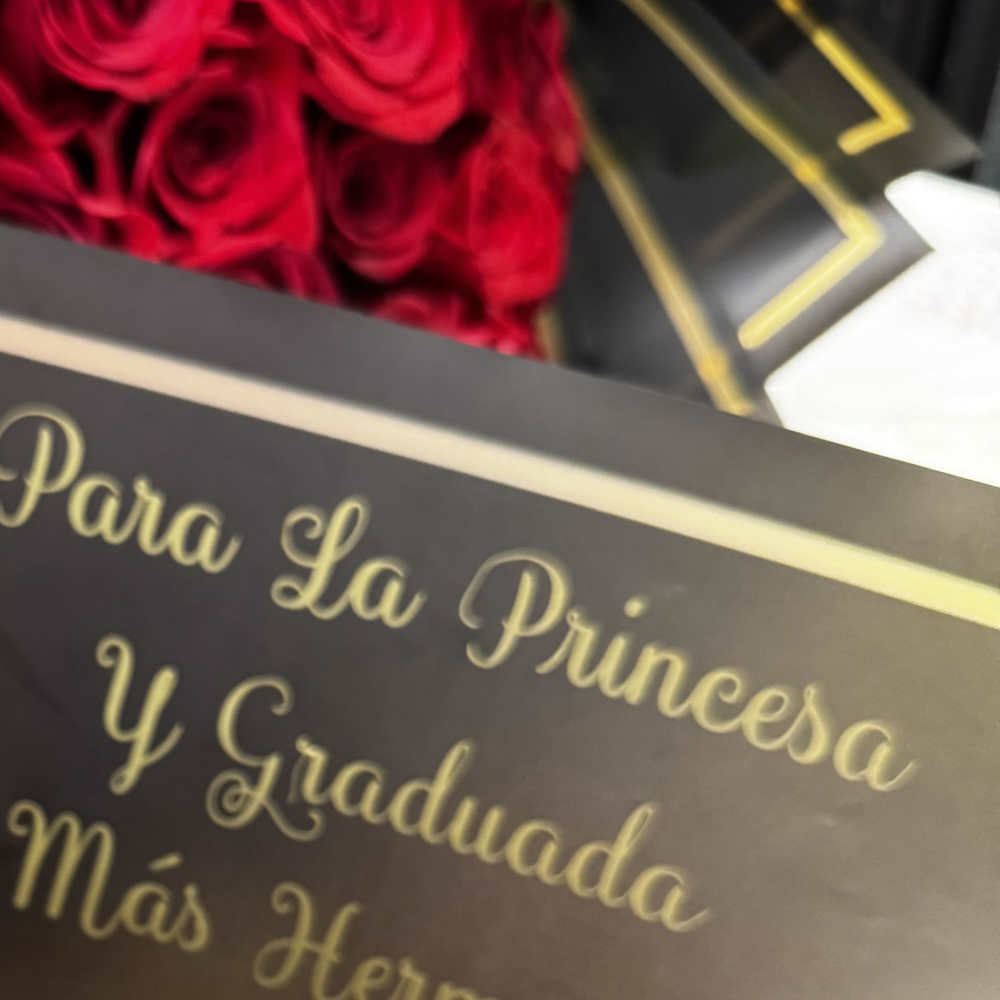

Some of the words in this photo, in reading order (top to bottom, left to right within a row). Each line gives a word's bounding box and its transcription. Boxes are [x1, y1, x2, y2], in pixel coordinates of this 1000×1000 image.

[95, 634, 185, 795] Y
[206, 675, 710, 933] Graduada
[270, 495, 427, 628] La
[459, 548, 918, 792] Princesa
[7, 799, 210, 953] Más
